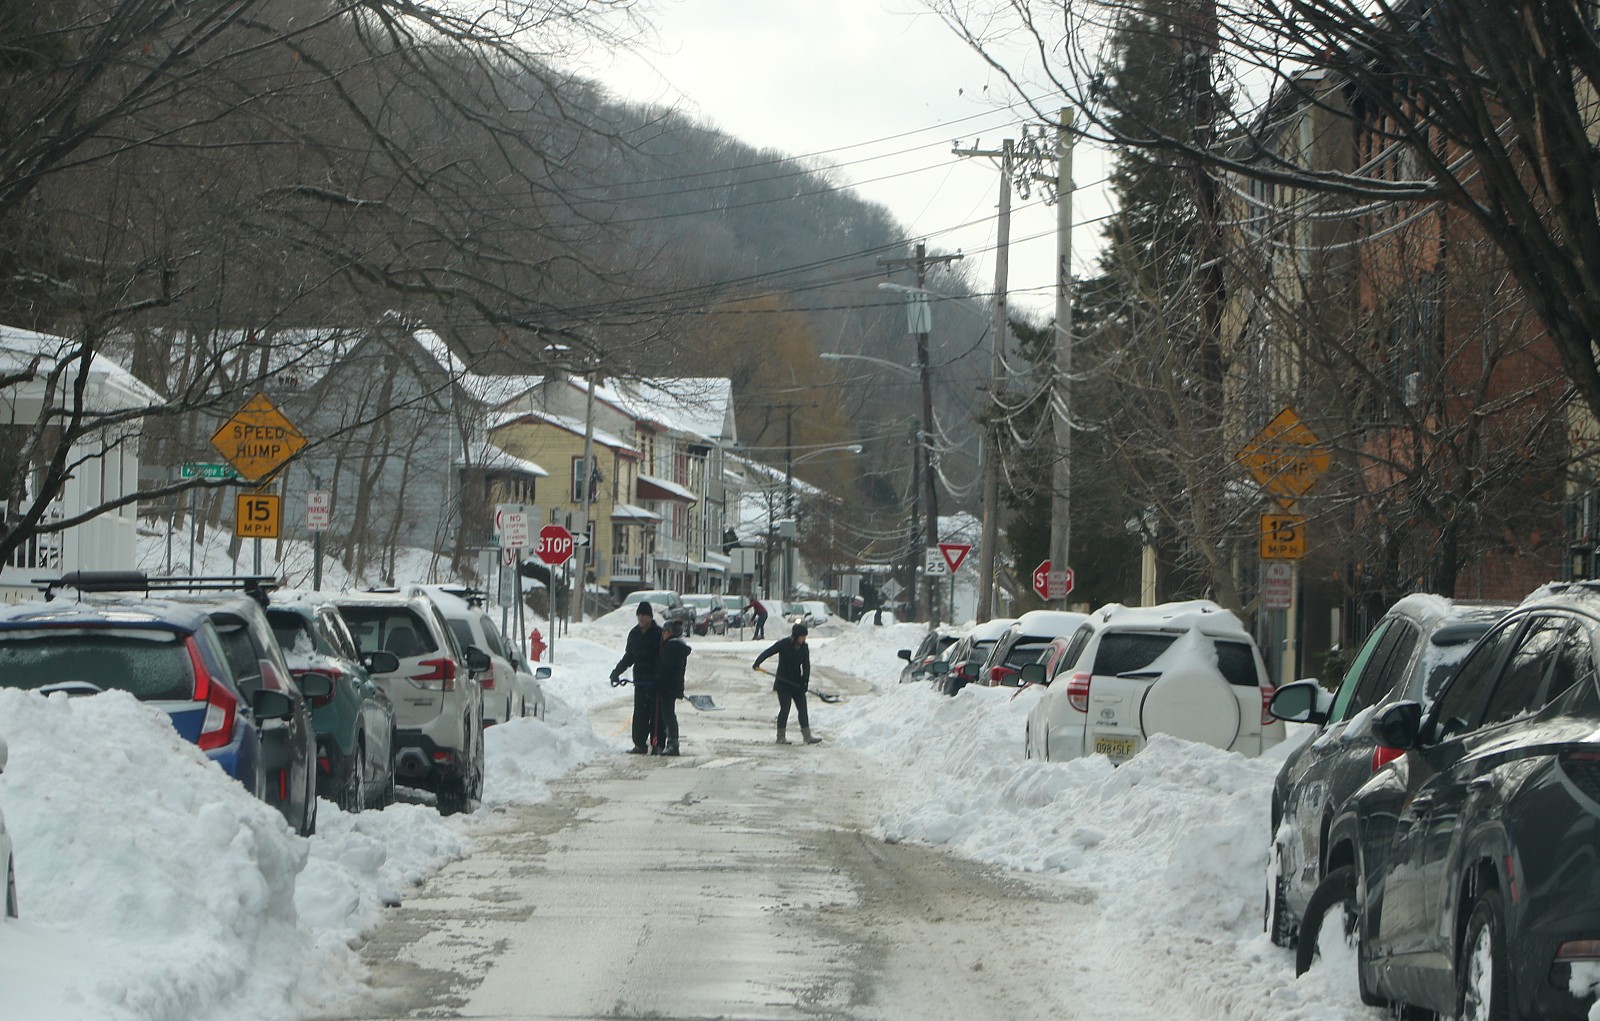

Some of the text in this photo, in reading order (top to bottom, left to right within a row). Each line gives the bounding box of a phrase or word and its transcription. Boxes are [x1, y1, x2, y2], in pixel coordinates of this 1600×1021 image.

[233, 425, 284, 440] SPEED
[236, 444, 280, 458] HUMP
[313, 496, 322, 504] NO
[246, 500, 270, 521] 15
[244, 524, 272, 533] MPH
[1270, 521, 1295, 542] 15
[539, 537, 571, 553] STOP
[1268, 545, 1298, 553] MPH
[927, 562, 945, 572] 25
[1273, 567, 1284, 576] NO
